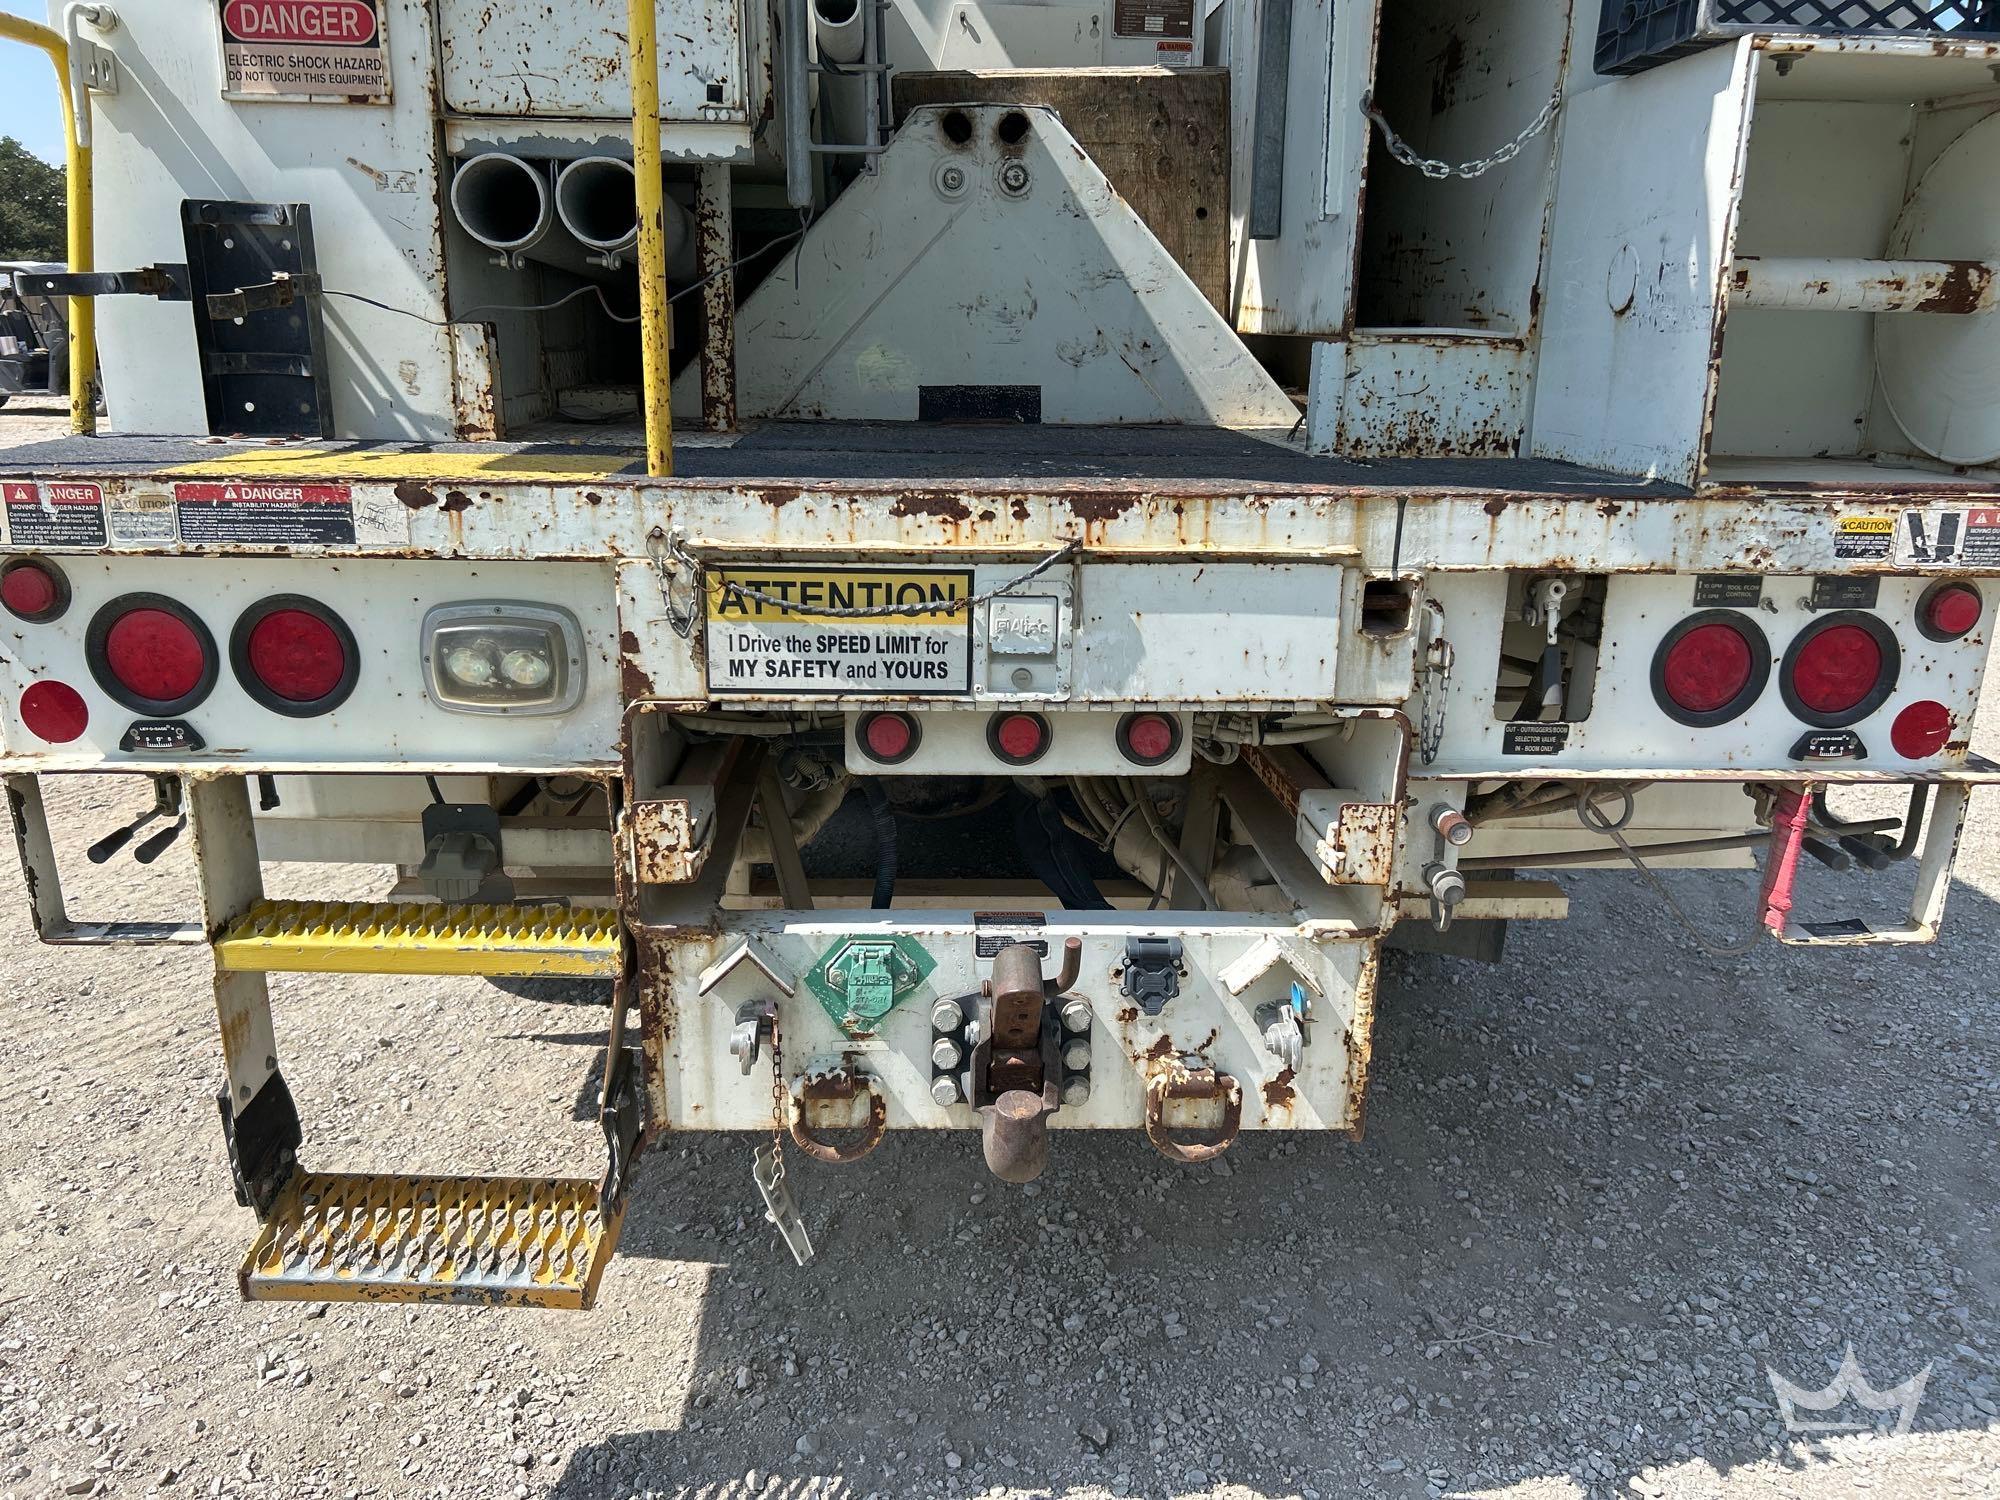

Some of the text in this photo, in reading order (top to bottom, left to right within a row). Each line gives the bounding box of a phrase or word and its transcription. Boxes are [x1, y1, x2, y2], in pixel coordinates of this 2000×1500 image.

[240, 4, 360, 36] DANGER
[228, 54, 382, 71] ELECTRIC SHOCK HAZARD
[229, 70, 384, 85] DO NOT TOUCH THIS EQUIPMENT
[49, 488, 94, 500] ANGER
[241, 488, 303, 500] DANGER
[1849, 521, 1892, 530] CAUTION
[718, 580, 956, 617] ATTENTION
[729, 634, 948, 654] I Drive the SPEED LIMIT for
[729, 659, 948, 679] MY SAFETY and YOURS
